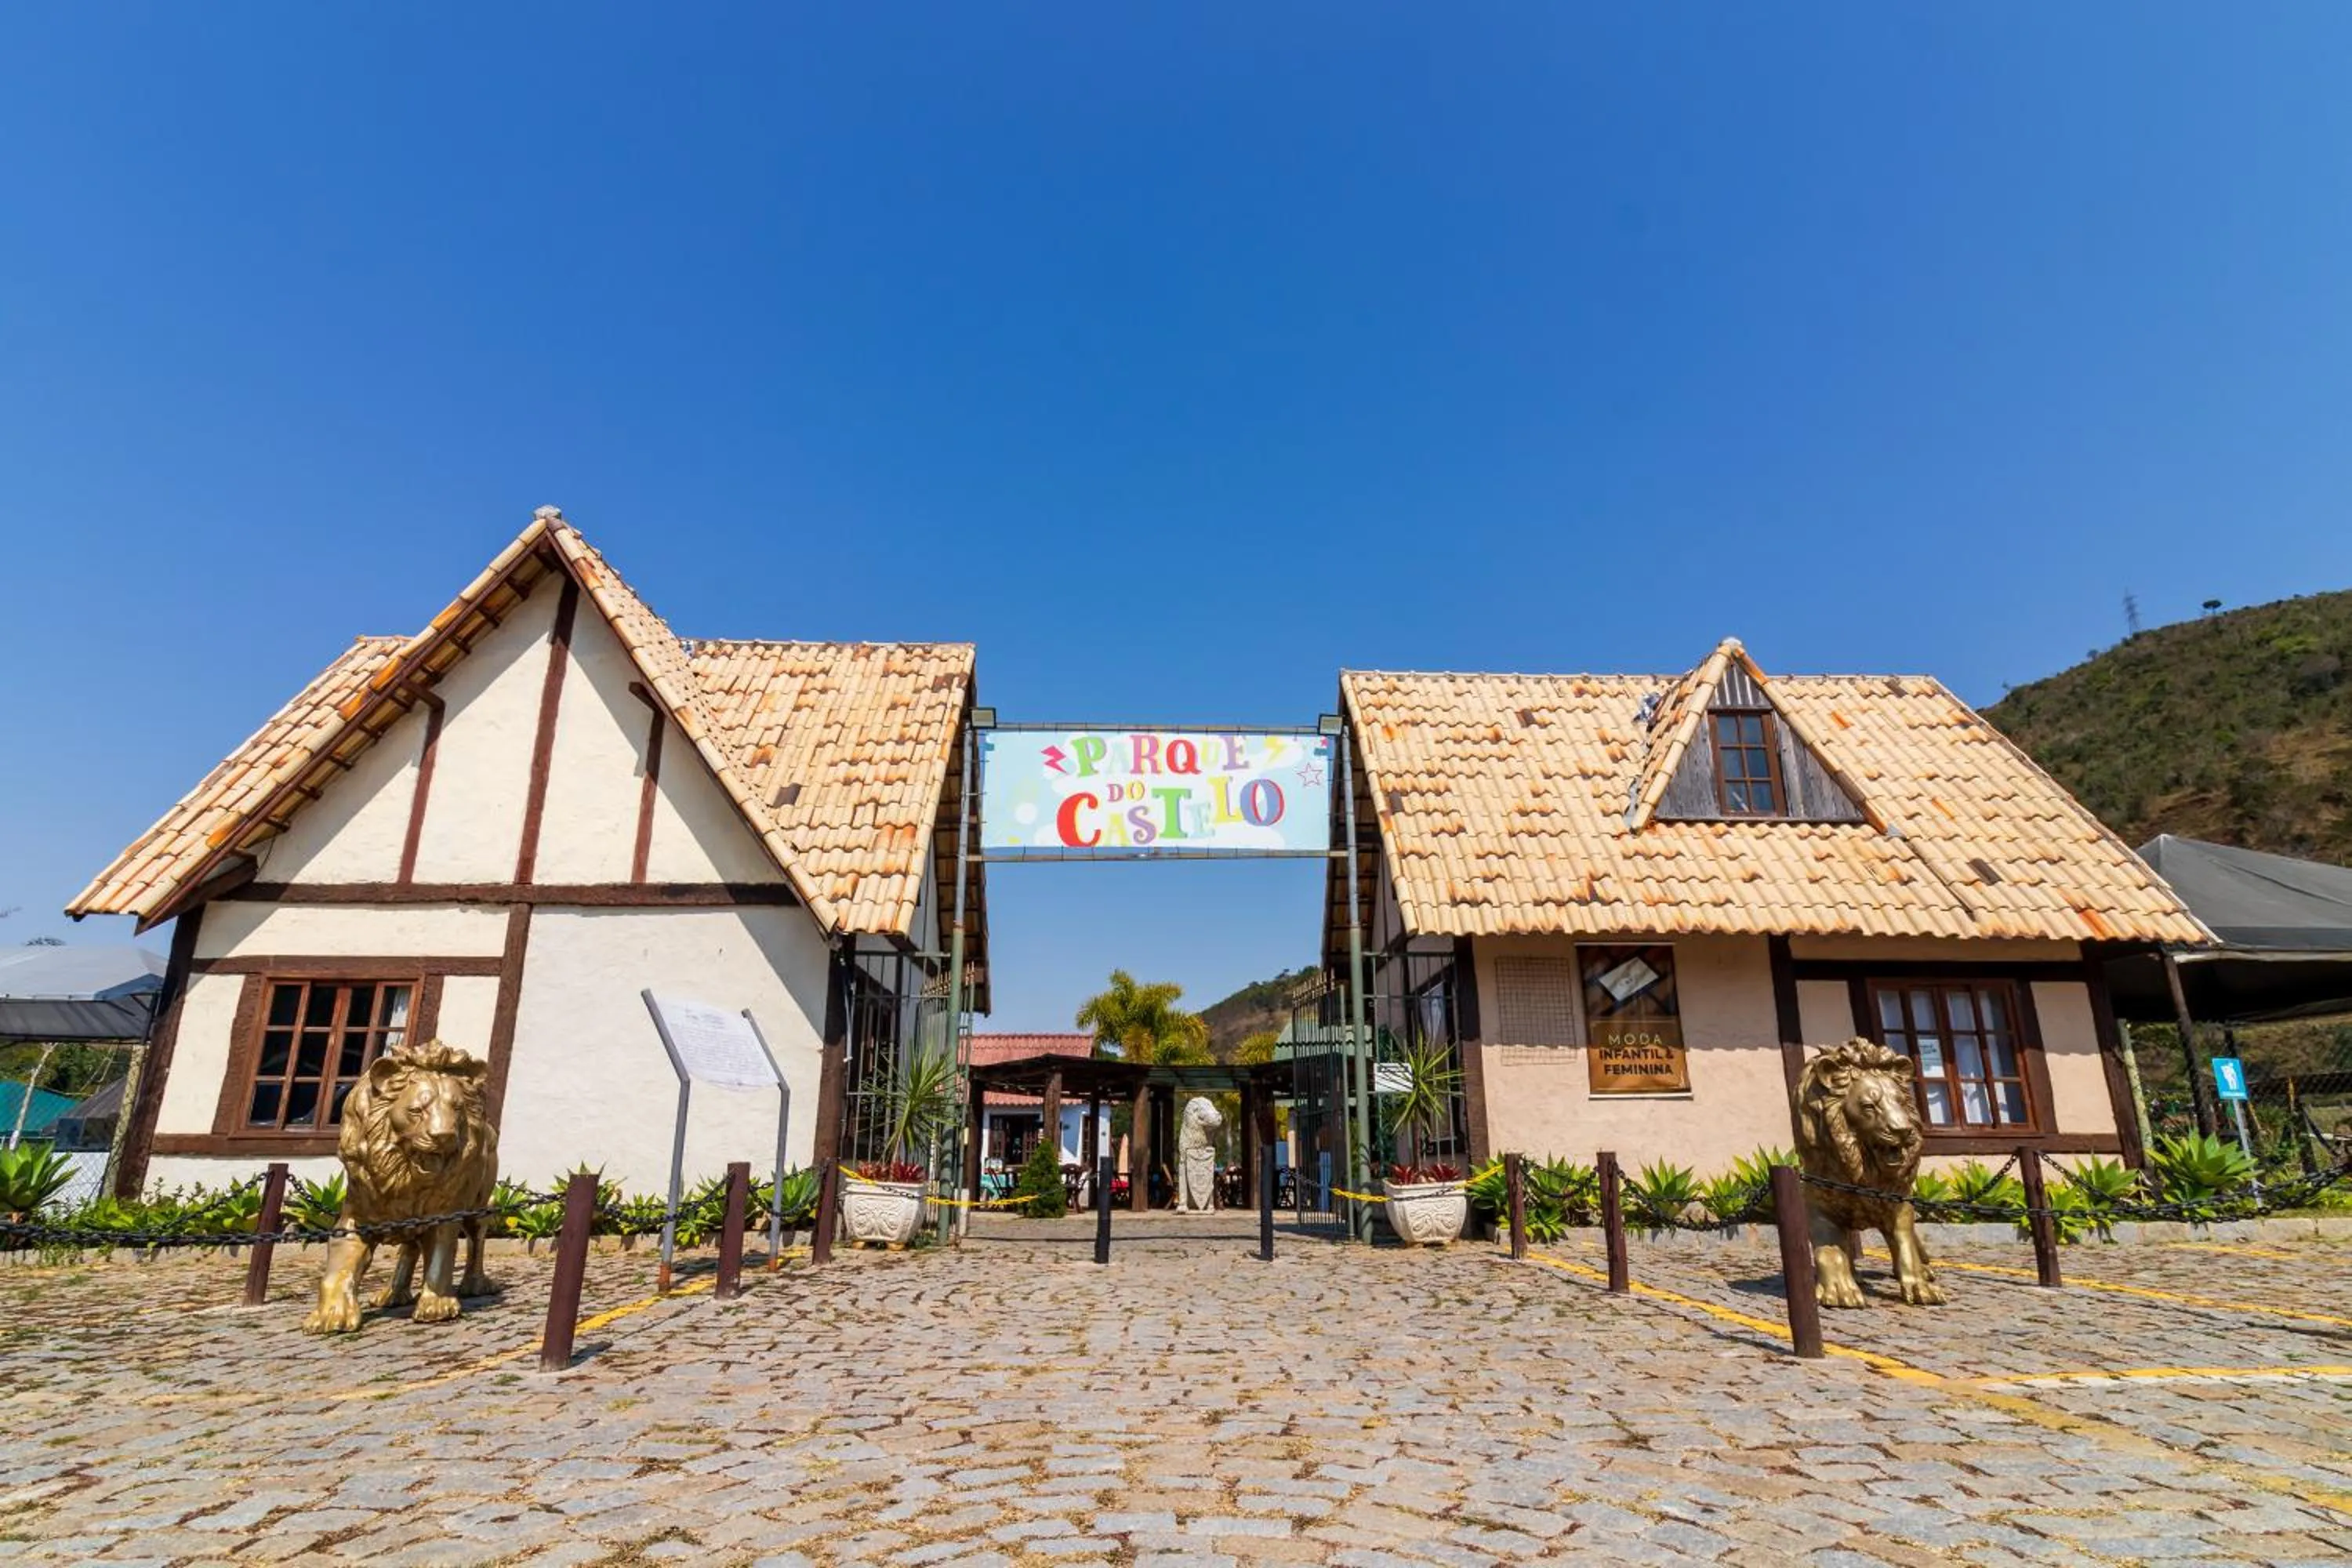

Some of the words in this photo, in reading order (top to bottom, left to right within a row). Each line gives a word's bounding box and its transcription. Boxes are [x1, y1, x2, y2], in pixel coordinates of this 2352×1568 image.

[1071, 735, 1249, 776] PARQUE
[1107, 781, 1145, 802] DO
[1056, 777, 1284, 847] CASTELO
[1608, 1033, 1661, 1044] MODA
[1599, 1048, 1663, 1059] INFANTIL
[1604, 1064, 1673, 1075] FEMININA
